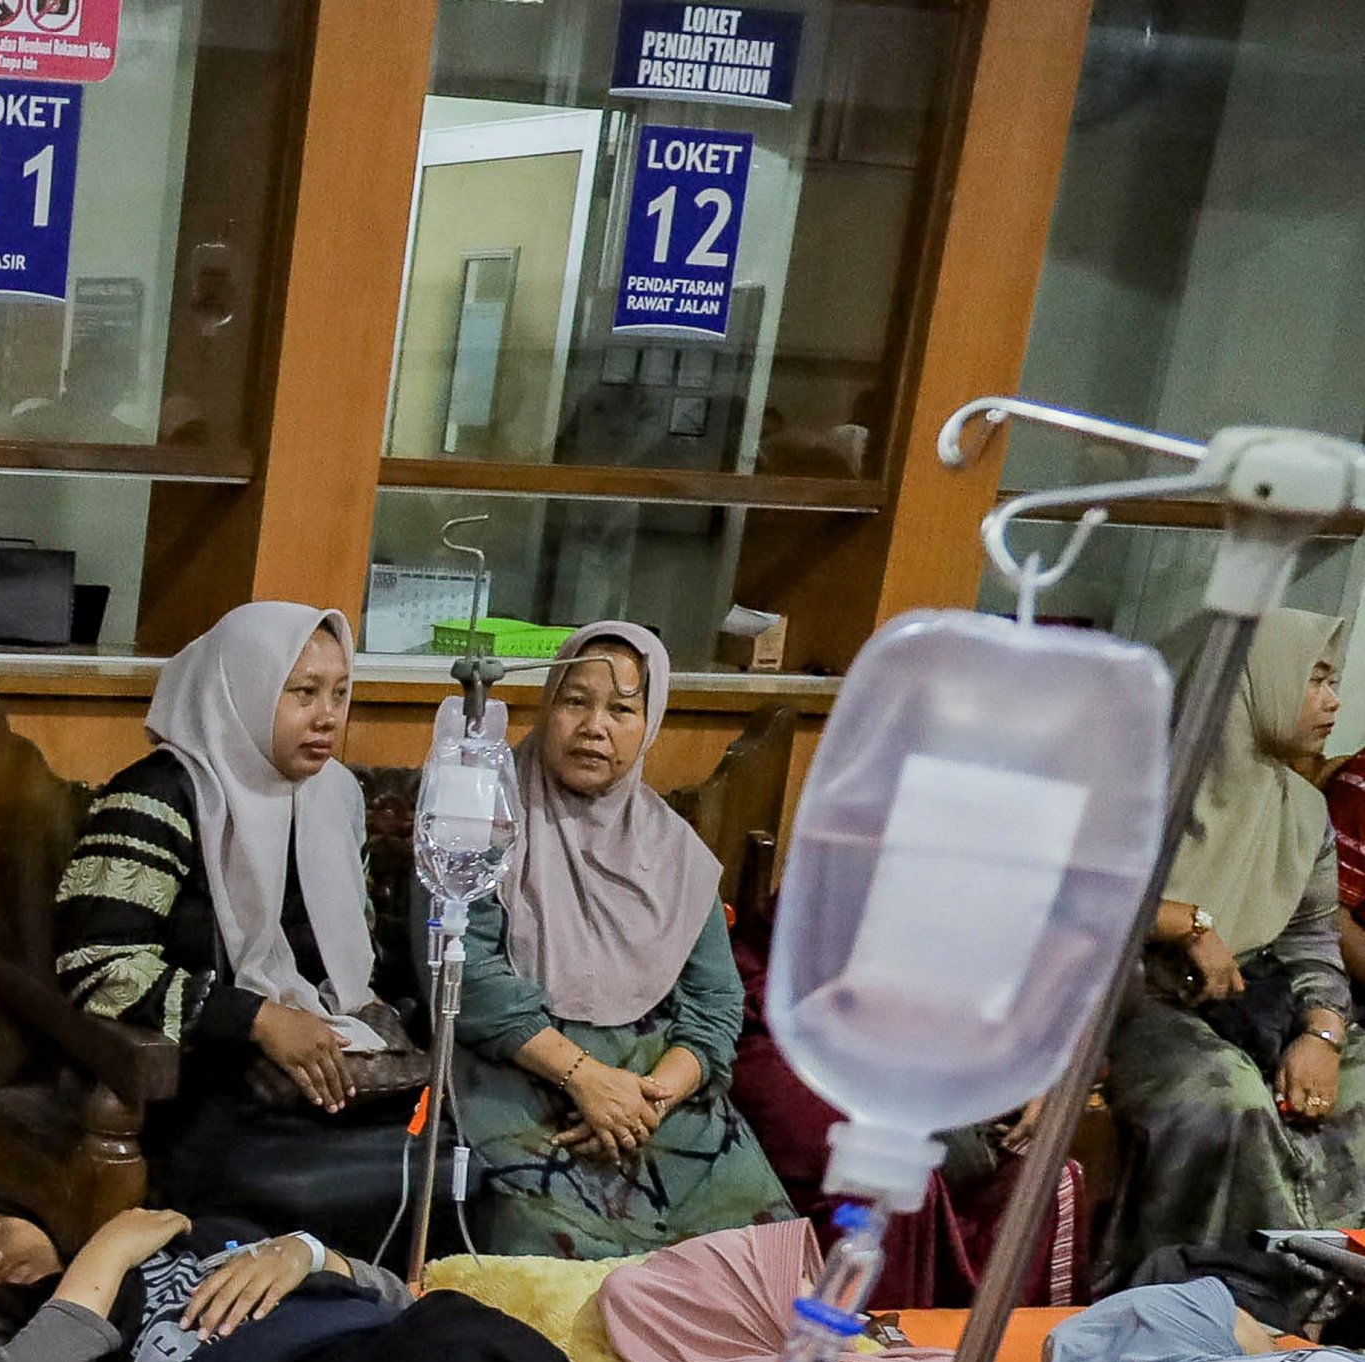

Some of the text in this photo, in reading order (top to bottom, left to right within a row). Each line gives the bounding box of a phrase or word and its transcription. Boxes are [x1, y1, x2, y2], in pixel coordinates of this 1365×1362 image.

[682, 6, 742, 36] LOKET
[641, 30, 774, 68] PENDAFTARAN
[637, 58, 771, 95] PASIEN UMUM
[647, 139, 743, 175] LOKET
[647, 185, 732, 267] 12
[627, 275, 724, 296] PENDAFTARAN
[627, 295, 720, 315] RAWAT JALAN
